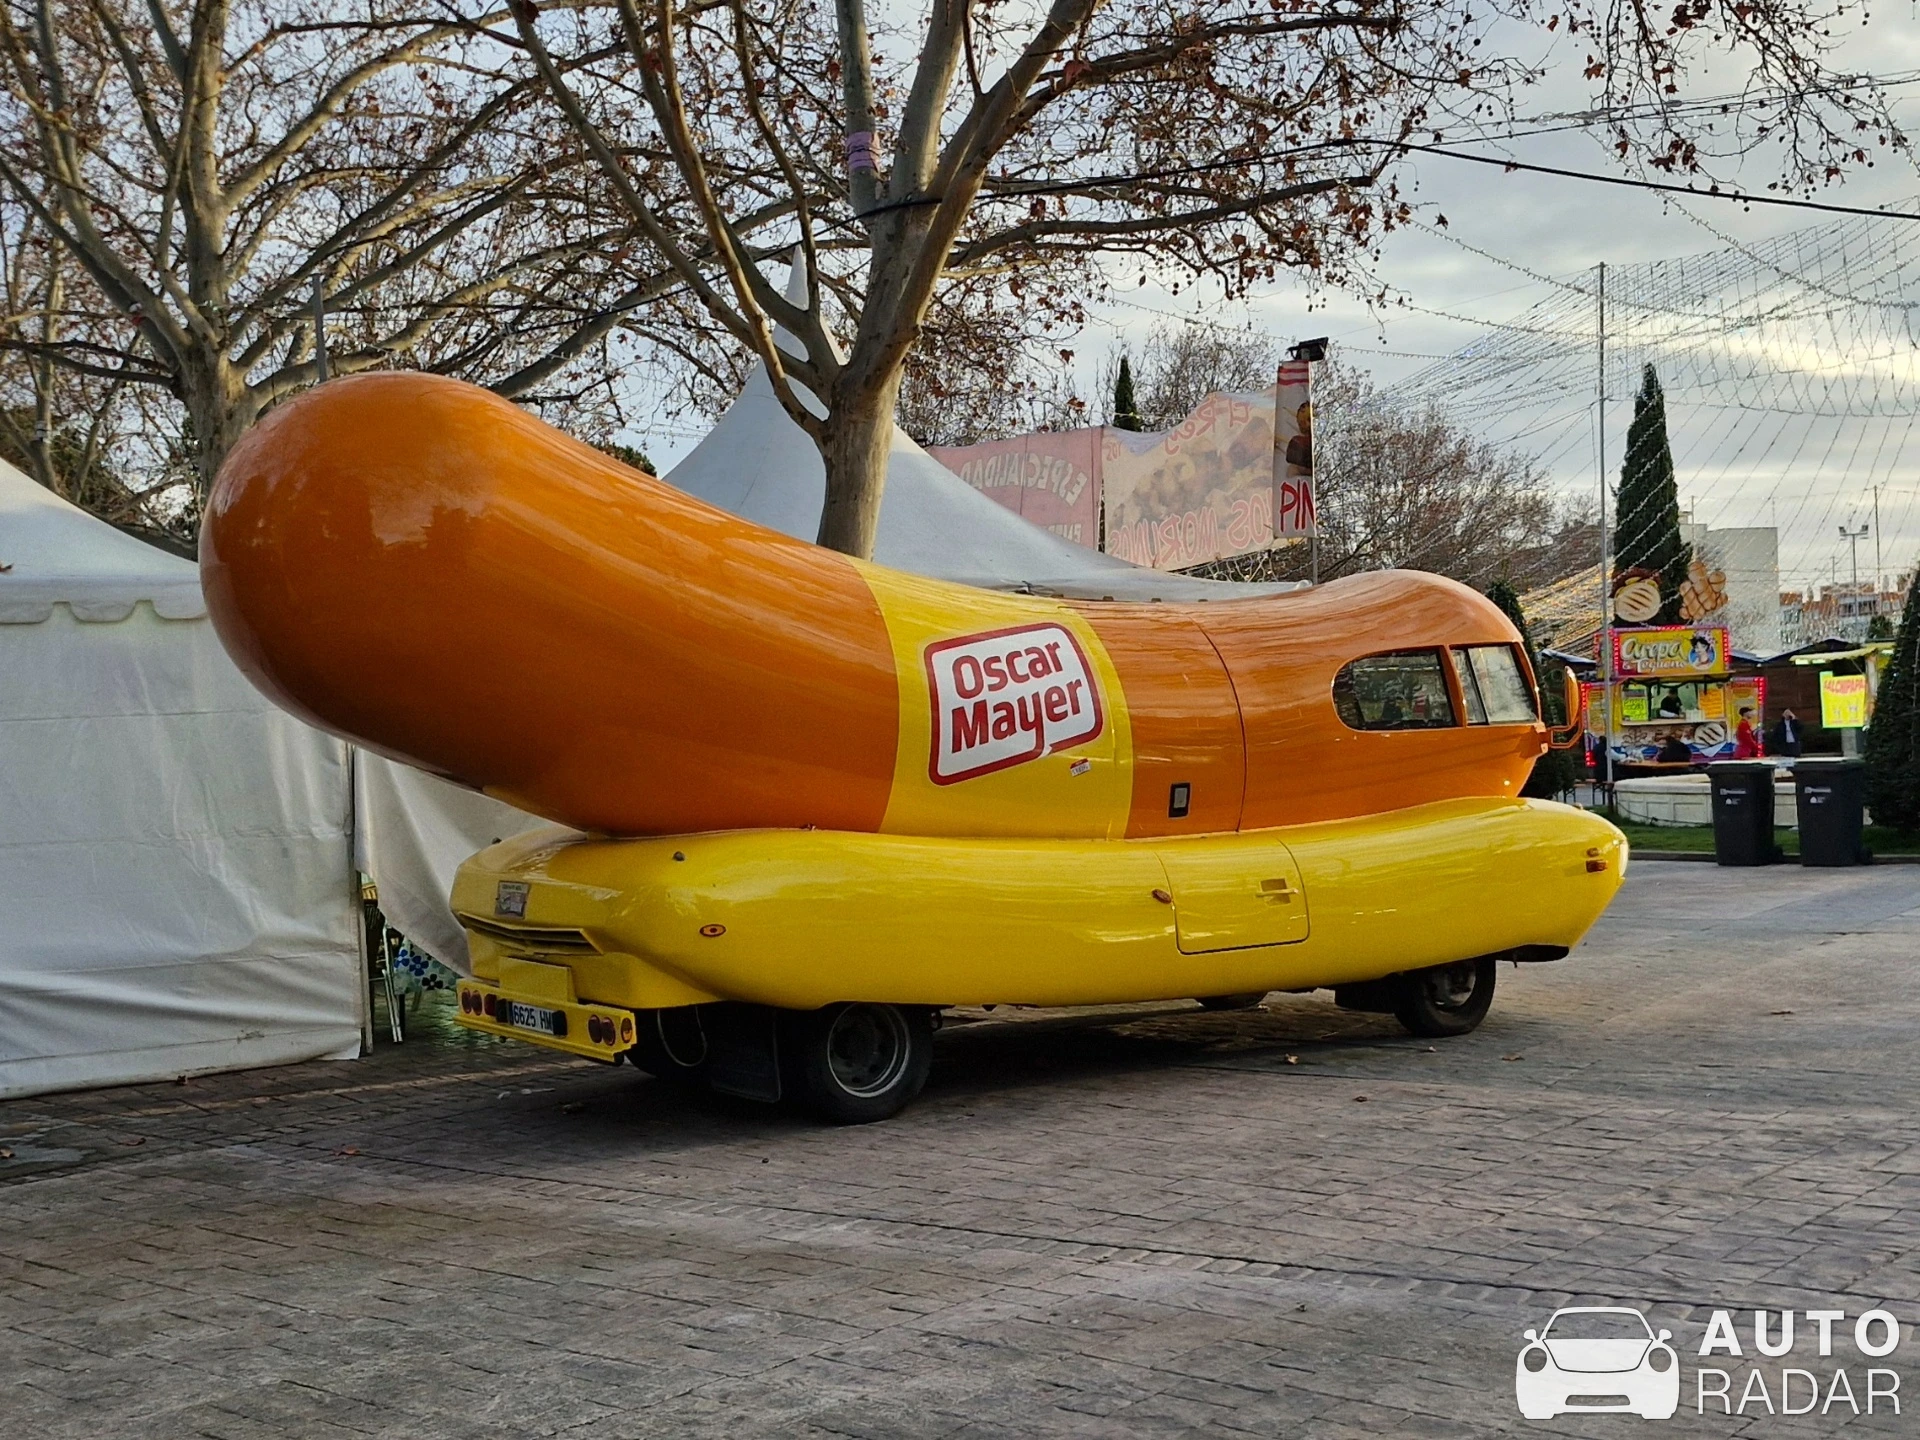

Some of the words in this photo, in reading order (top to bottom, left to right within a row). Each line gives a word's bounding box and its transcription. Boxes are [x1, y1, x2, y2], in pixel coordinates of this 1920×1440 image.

[951, 641, 1064, 699] Oscar
[951, 679, 1082, 755] Mayer
[513, 1004, 536, 1028] 6625
